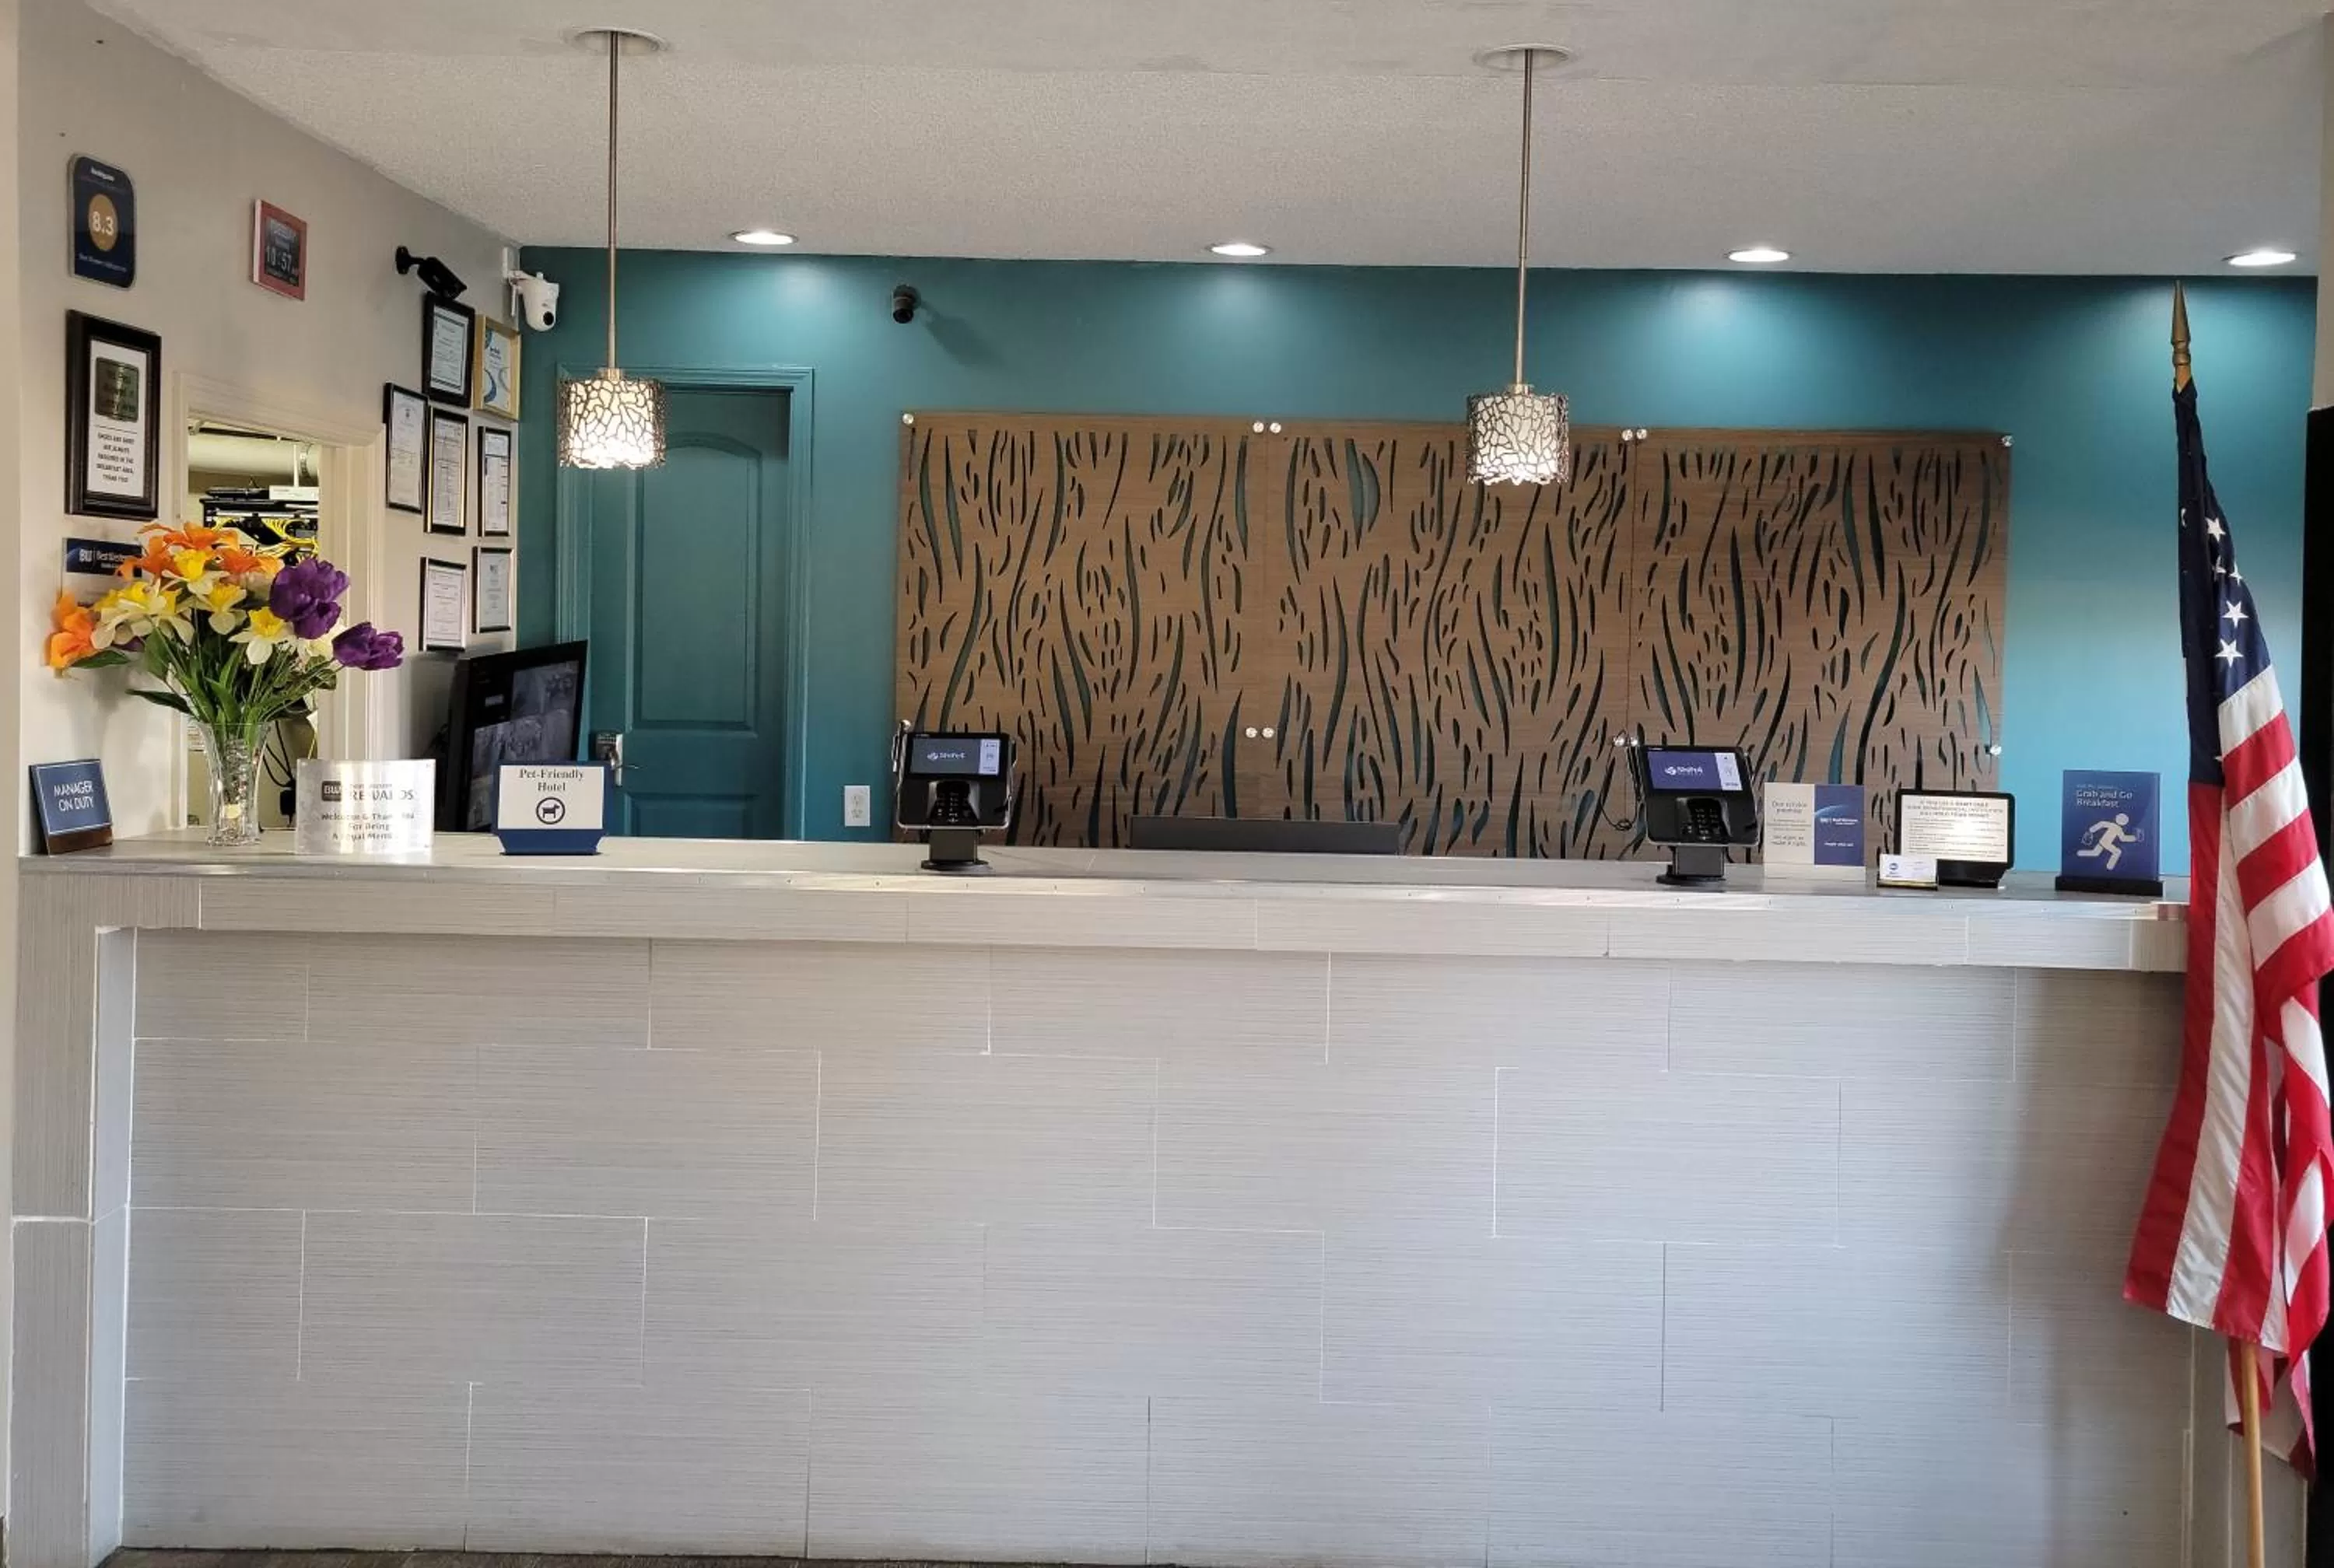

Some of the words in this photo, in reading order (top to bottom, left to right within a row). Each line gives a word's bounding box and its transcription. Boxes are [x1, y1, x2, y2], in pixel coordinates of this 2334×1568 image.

[93, 211, 114, 236] 8.3
[519, 768, 584, 781] Pet-Friendly
[54, 780, 93, 796] MANAGER
[538, 782, 566, 791] Hotel
[2076, 789, 2098, 798] Grab
[2118, 790, 2133, 800] Go
[58, 799, 73, 811] ON
[74, 796, 93, 810] DUTY
[2076, 799, 2120, 808] Breakfast
